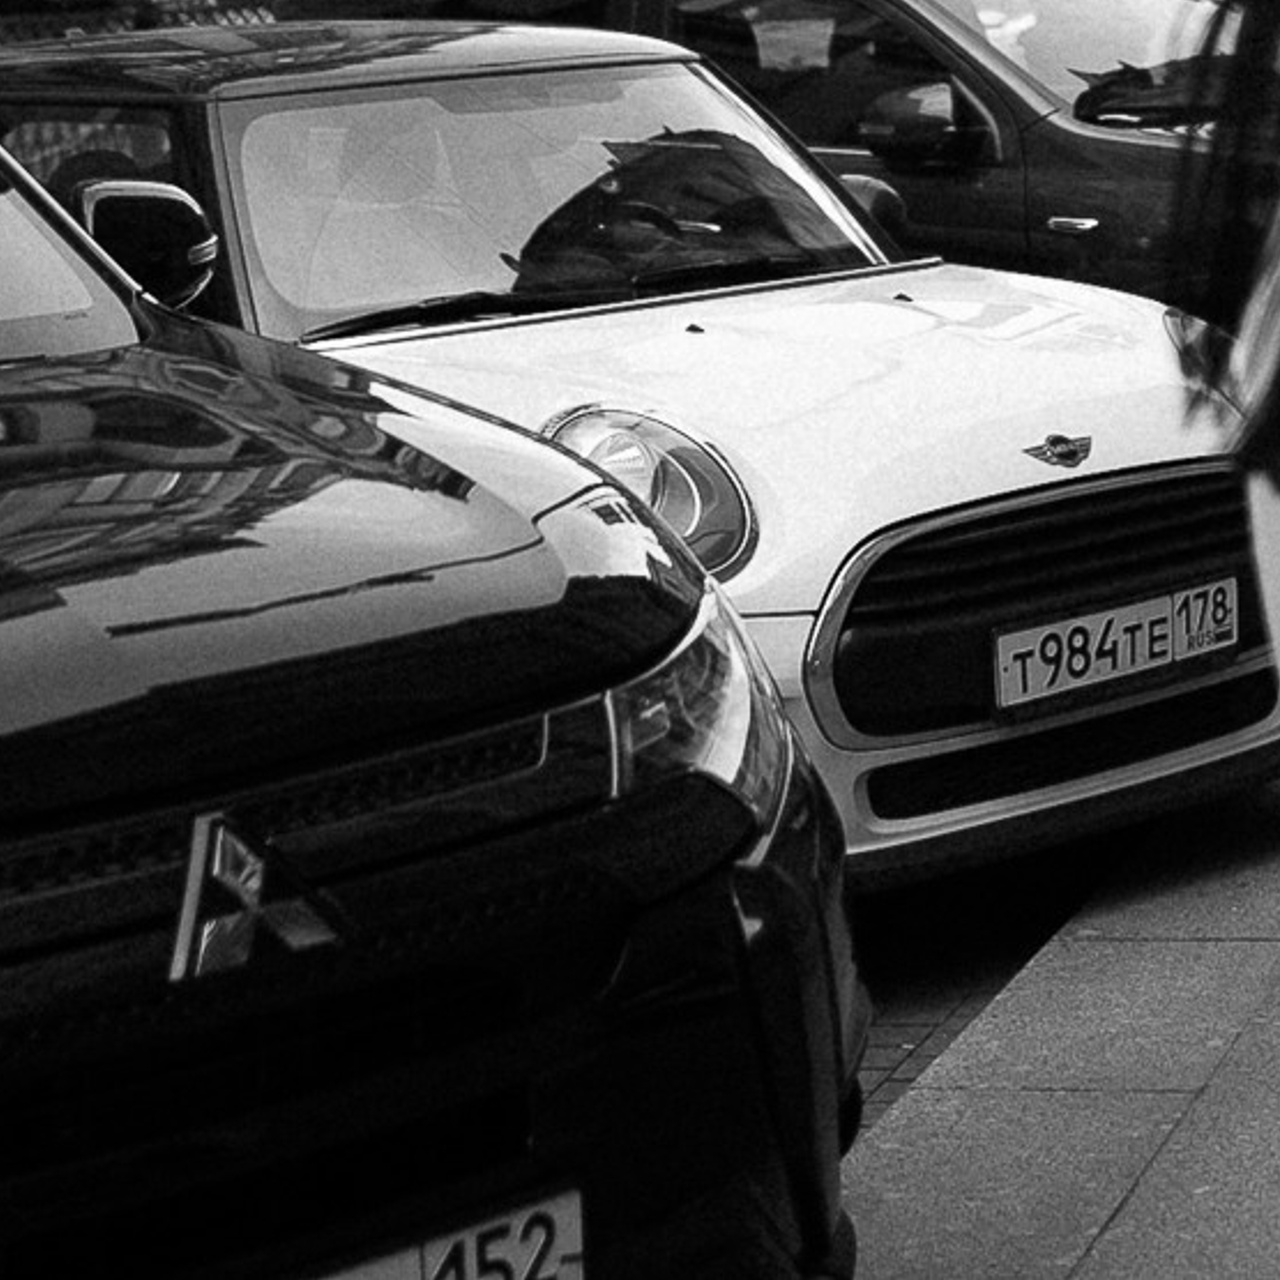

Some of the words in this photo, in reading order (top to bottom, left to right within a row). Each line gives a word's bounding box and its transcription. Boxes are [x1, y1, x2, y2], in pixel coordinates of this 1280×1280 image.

[1012, 616, 1169, 694] T984TE
[1176, 586, 1229, 636] 178
[1187, 629, 1213, 652] RUS
